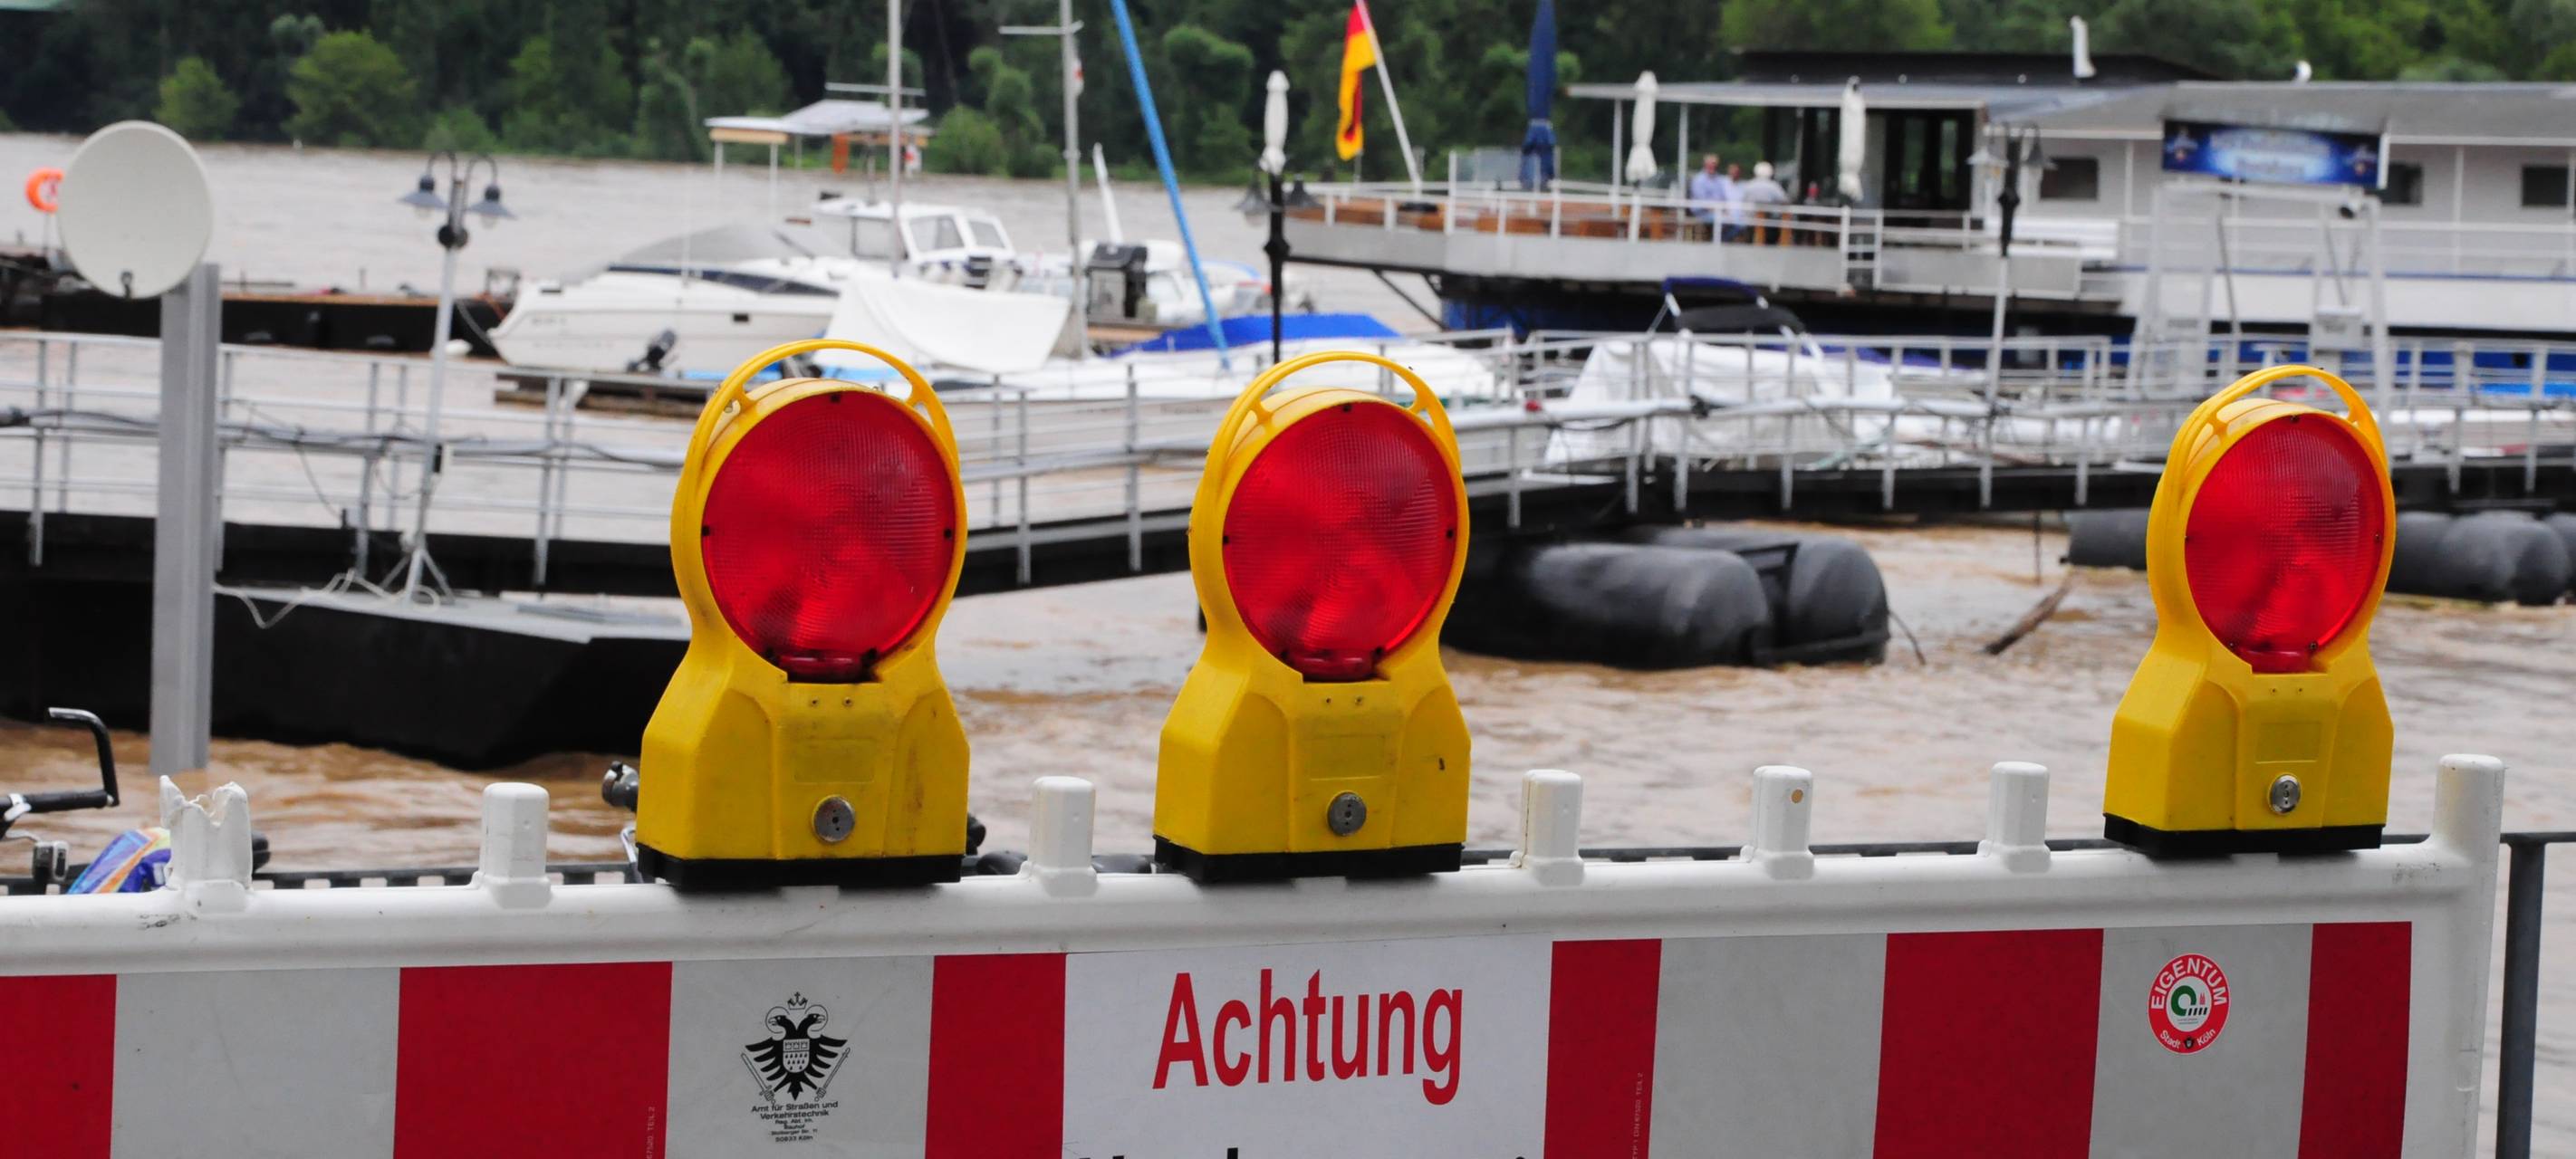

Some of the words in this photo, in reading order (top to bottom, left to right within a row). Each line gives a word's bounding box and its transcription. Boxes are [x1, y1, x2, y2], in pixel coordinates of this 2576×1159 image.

[2150, 958, 2228, 1010] EIGENTUM
[1152, 968, 1463, 1106] Achtung
[2159, 1030, 2181, 1049] Stadt
[2196, 1029, 2216, 1046] Köln
[761, 1110, 829, 1119] Verkehrstechnik
